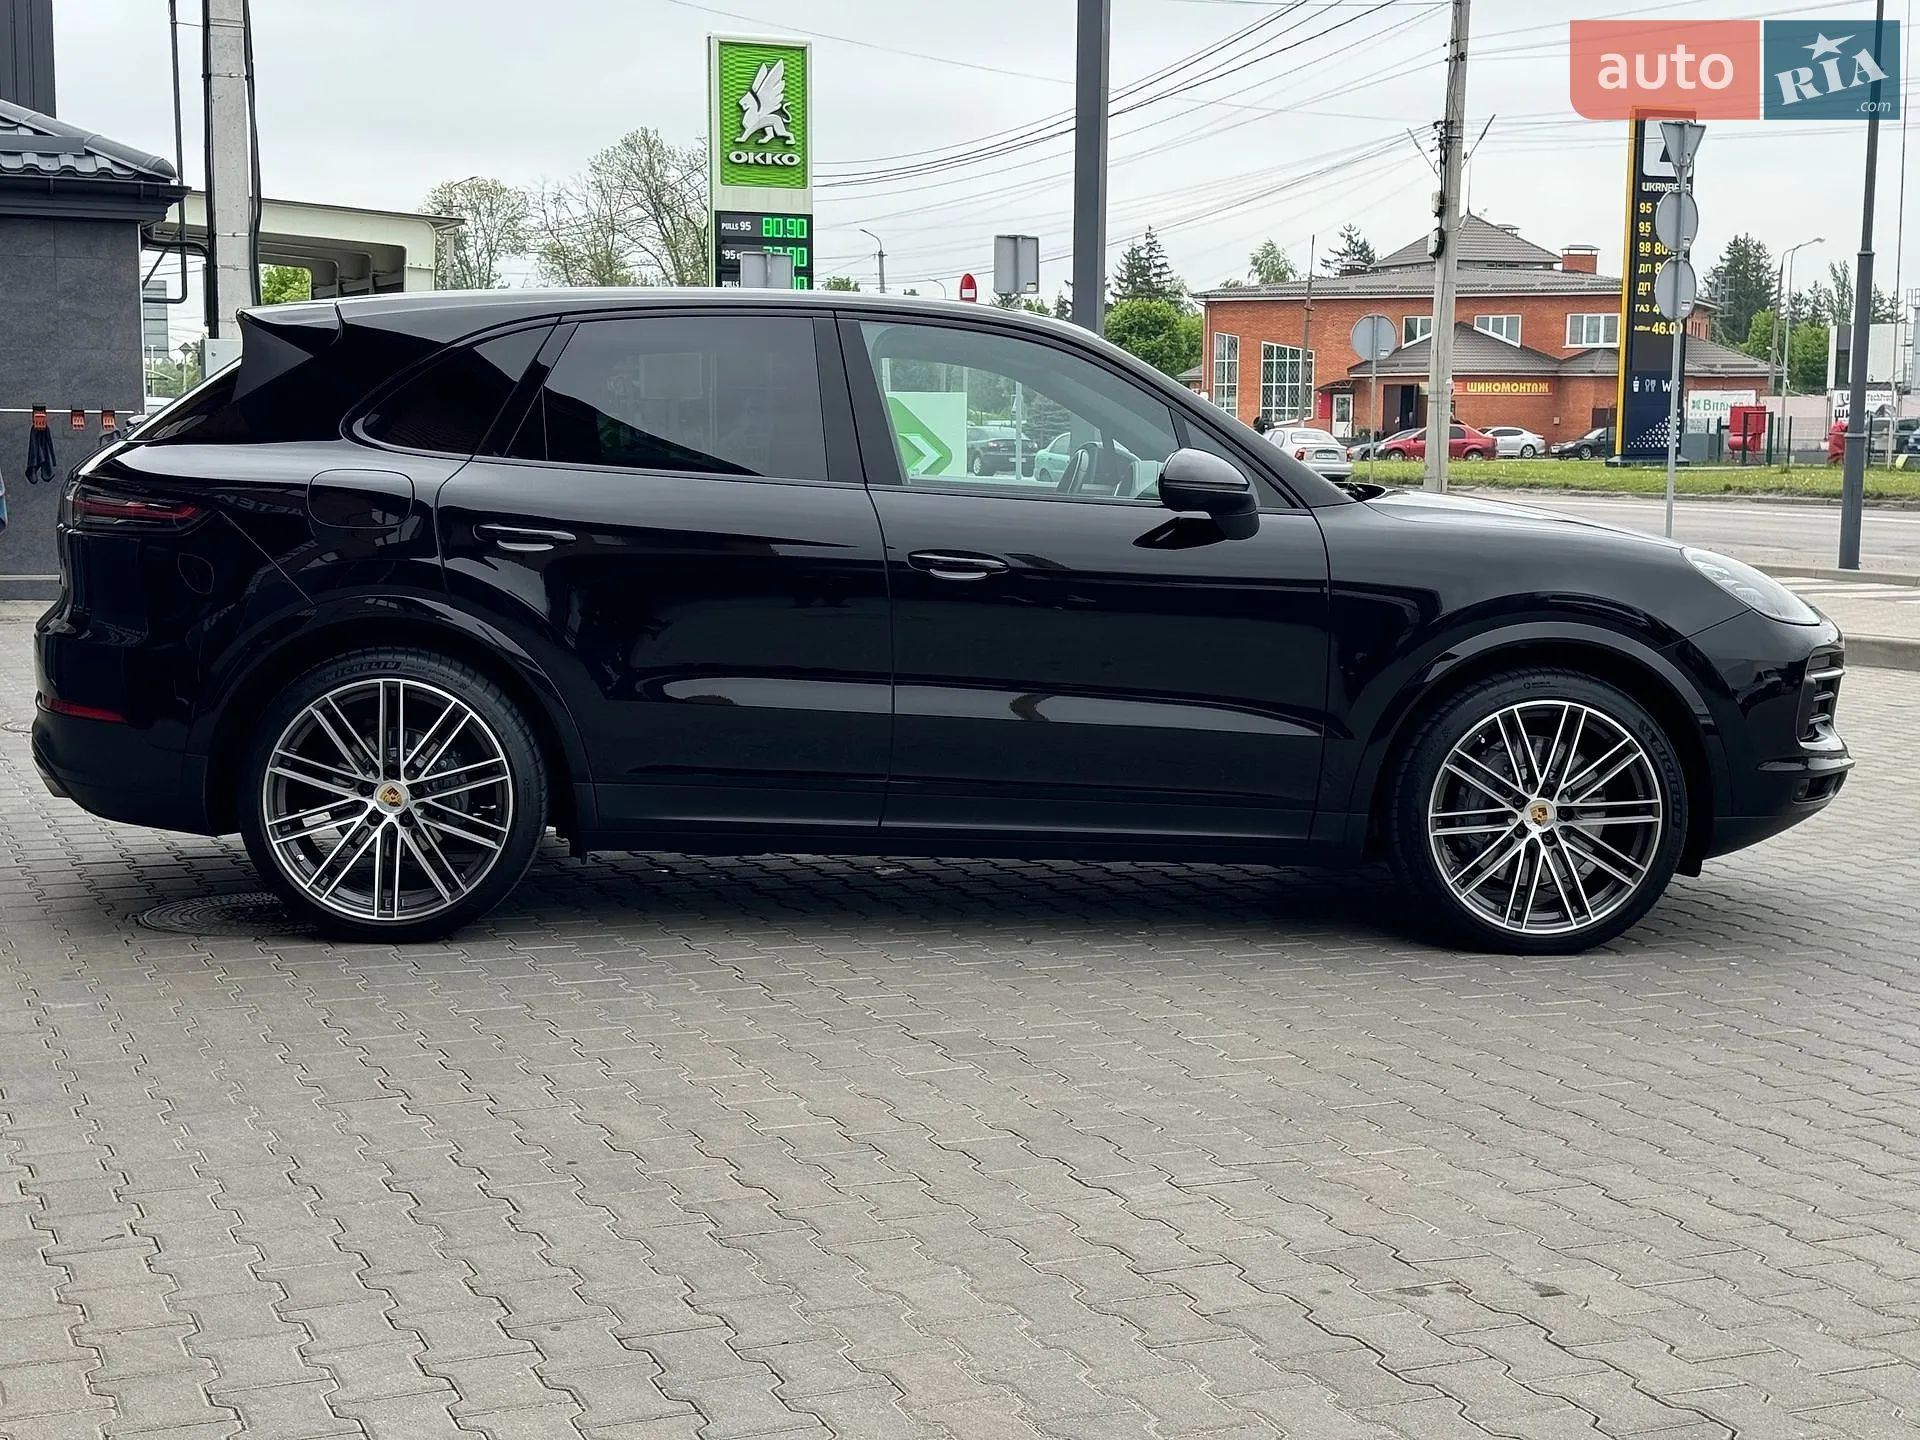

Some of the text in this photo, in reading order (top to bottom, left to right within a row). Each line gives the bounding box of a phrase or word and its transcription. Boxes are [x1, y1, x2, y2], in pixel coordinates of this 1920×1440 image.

[729, 151, 801, 166] OKKO
[1639, 202, 1652, 213] 95
[721, 217, 808, 238] PULLS 95 80.90
[1638, 221, 1651, 233] 95
[1638, 241, 1651, 253] 98
[1638, 263, 1652, 274] ДП
[1638, 281, 1651, 292] ДП
[1635, 303, 1650, 313] ГАЗ
[1466, 382, 1549, 393] ШИНОМОНТАЖ
[324, 661, 400, 680] MICHELIN
